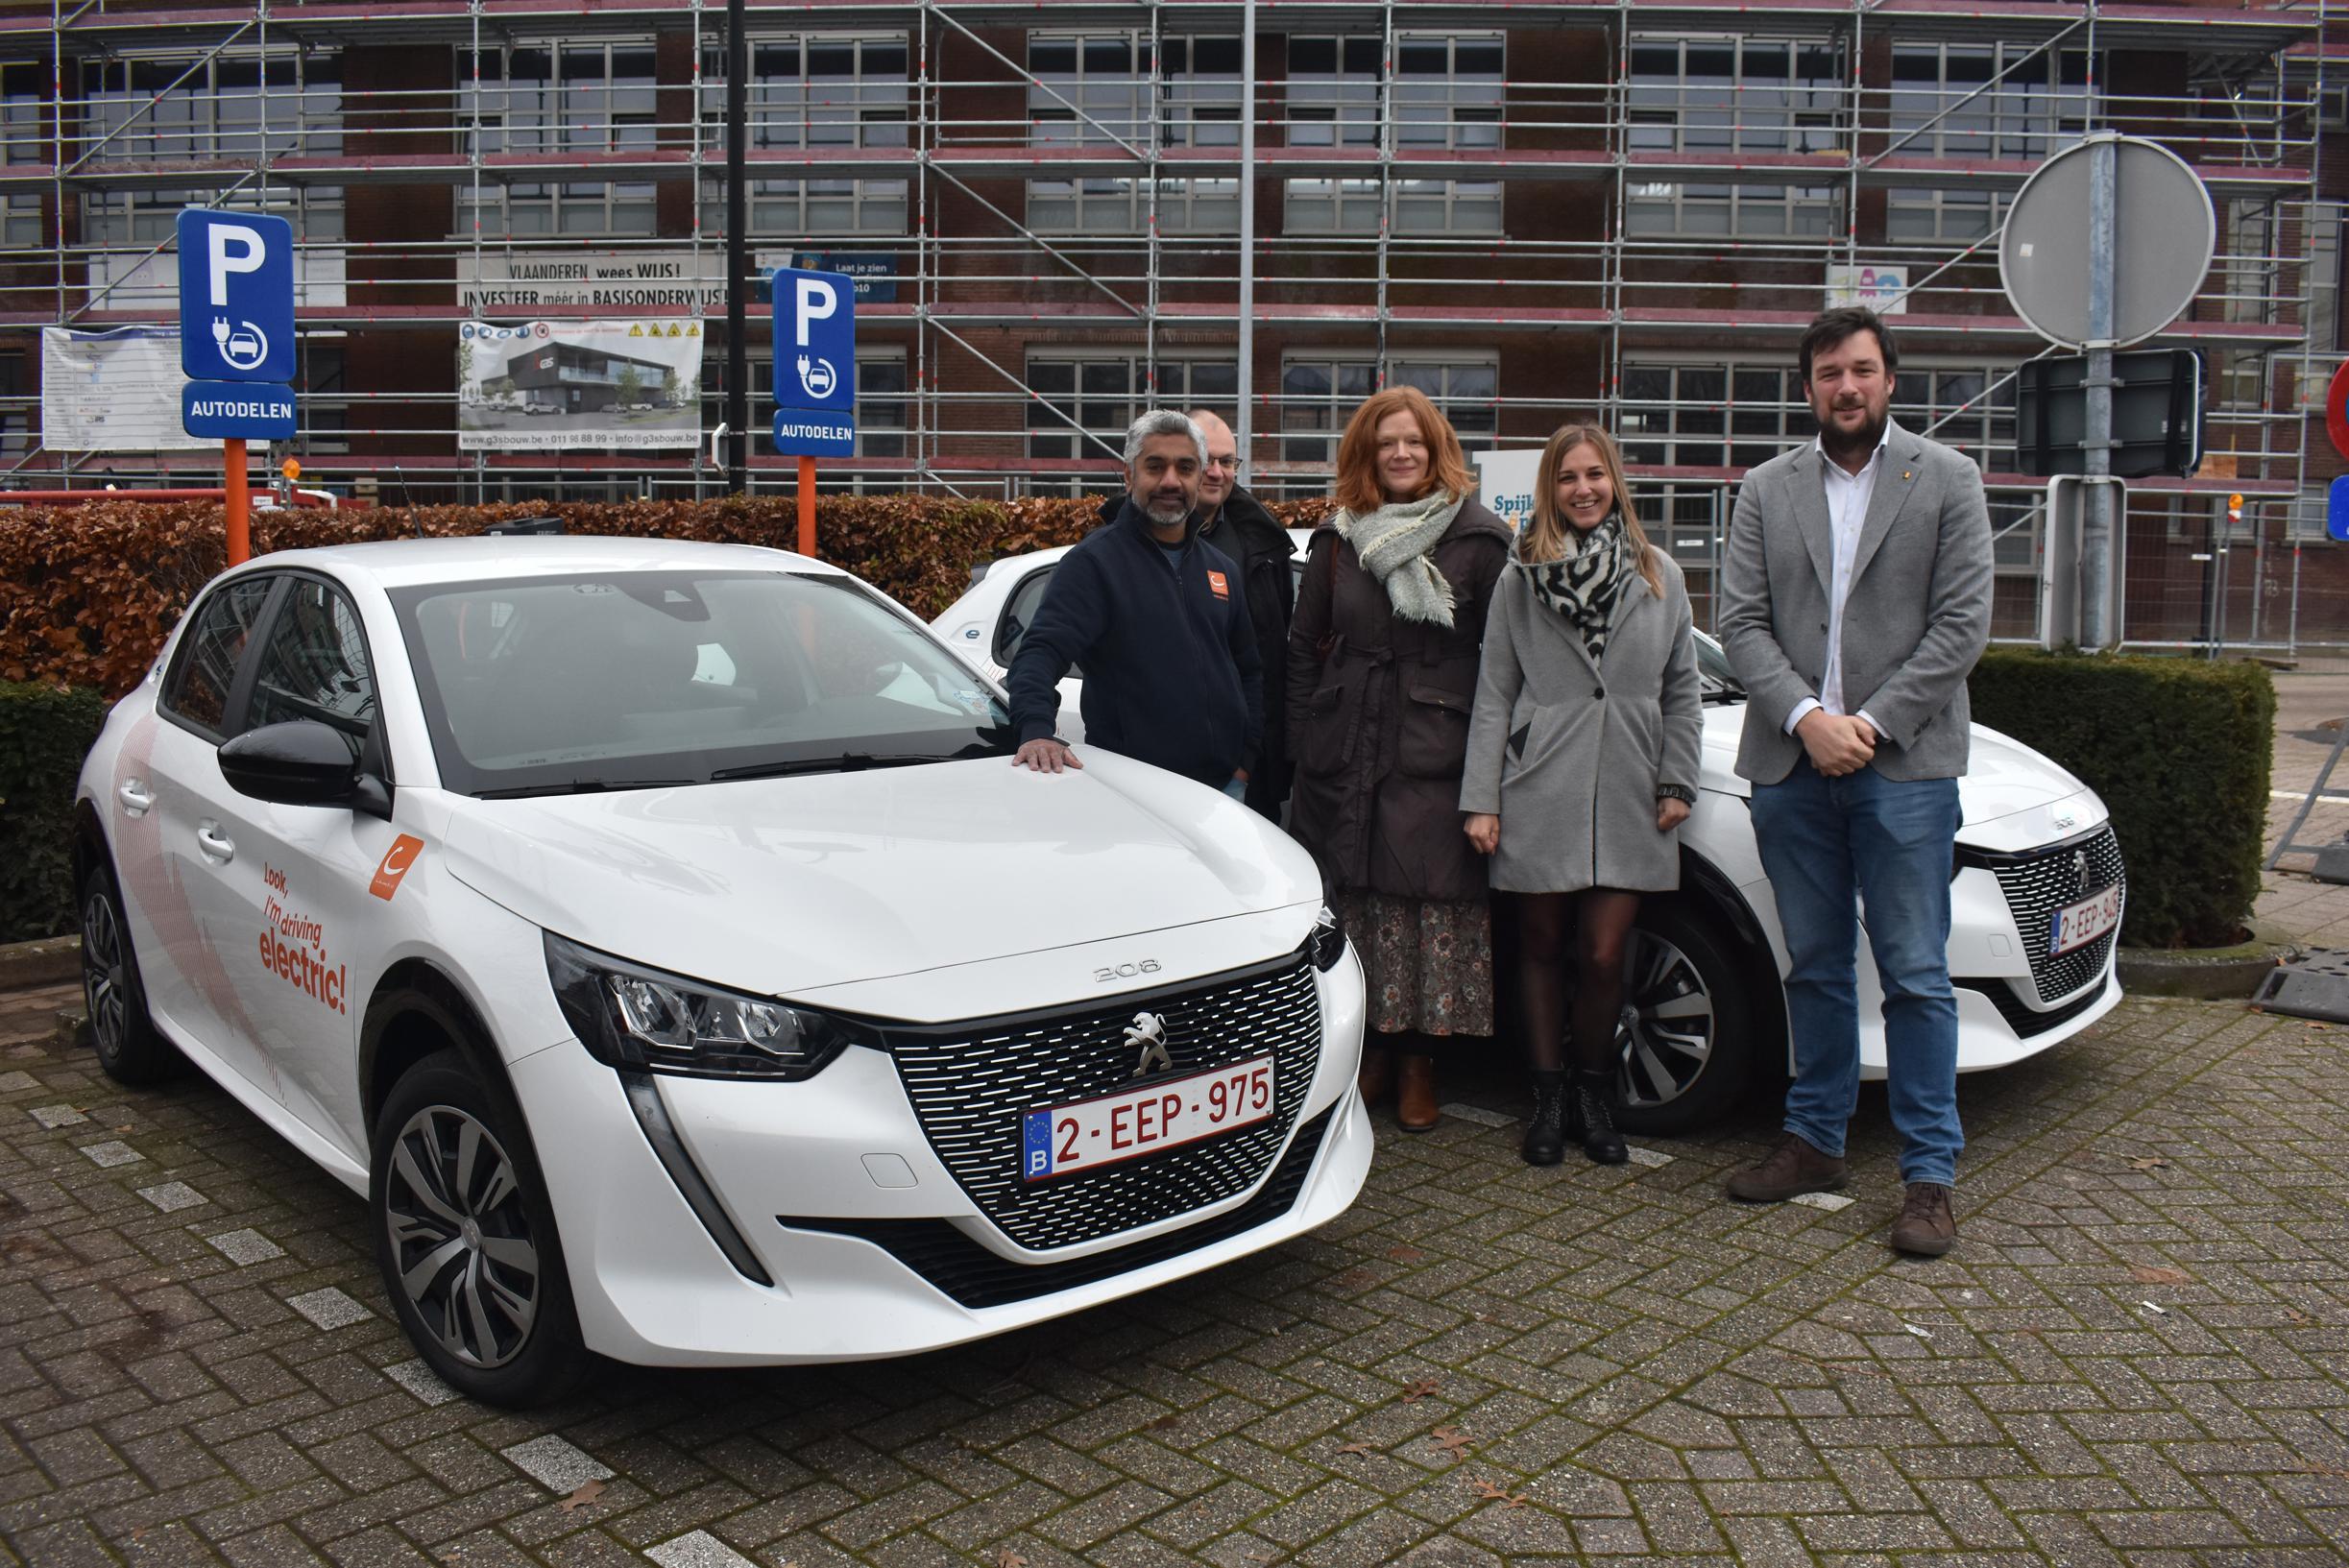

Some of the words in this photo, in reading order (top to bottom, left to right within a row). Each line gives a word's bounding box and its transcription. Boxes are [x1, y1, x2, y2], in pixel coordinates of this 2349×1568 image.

[208, 223, 266, 306] P
[509, 264, 589, 279] VLAANDEREN
[596, 268, 633, 278] wees
[835, 263, 855, 273] Laat
[856, 264, 866, 275] je
[867, 263, 887, 273] zien
[578, 291, 589, 305] in
[796, 277, 837, 347] P
[191, 400, 292, 420] AUTODELEN
[781, 423, 853, 441] AUTODELEN
[264, 861, 288, 899] Look,
[264, 895, 281, 925] I'm
[281, 913, 323, 951] driving
[259, 927, 347, 1016] electric!
[1093, 958, 1162, 983] 208
[1056, 1066, 1270, 1164] 2-EEP-975
[1031, 1149, 1048, 1172] B
